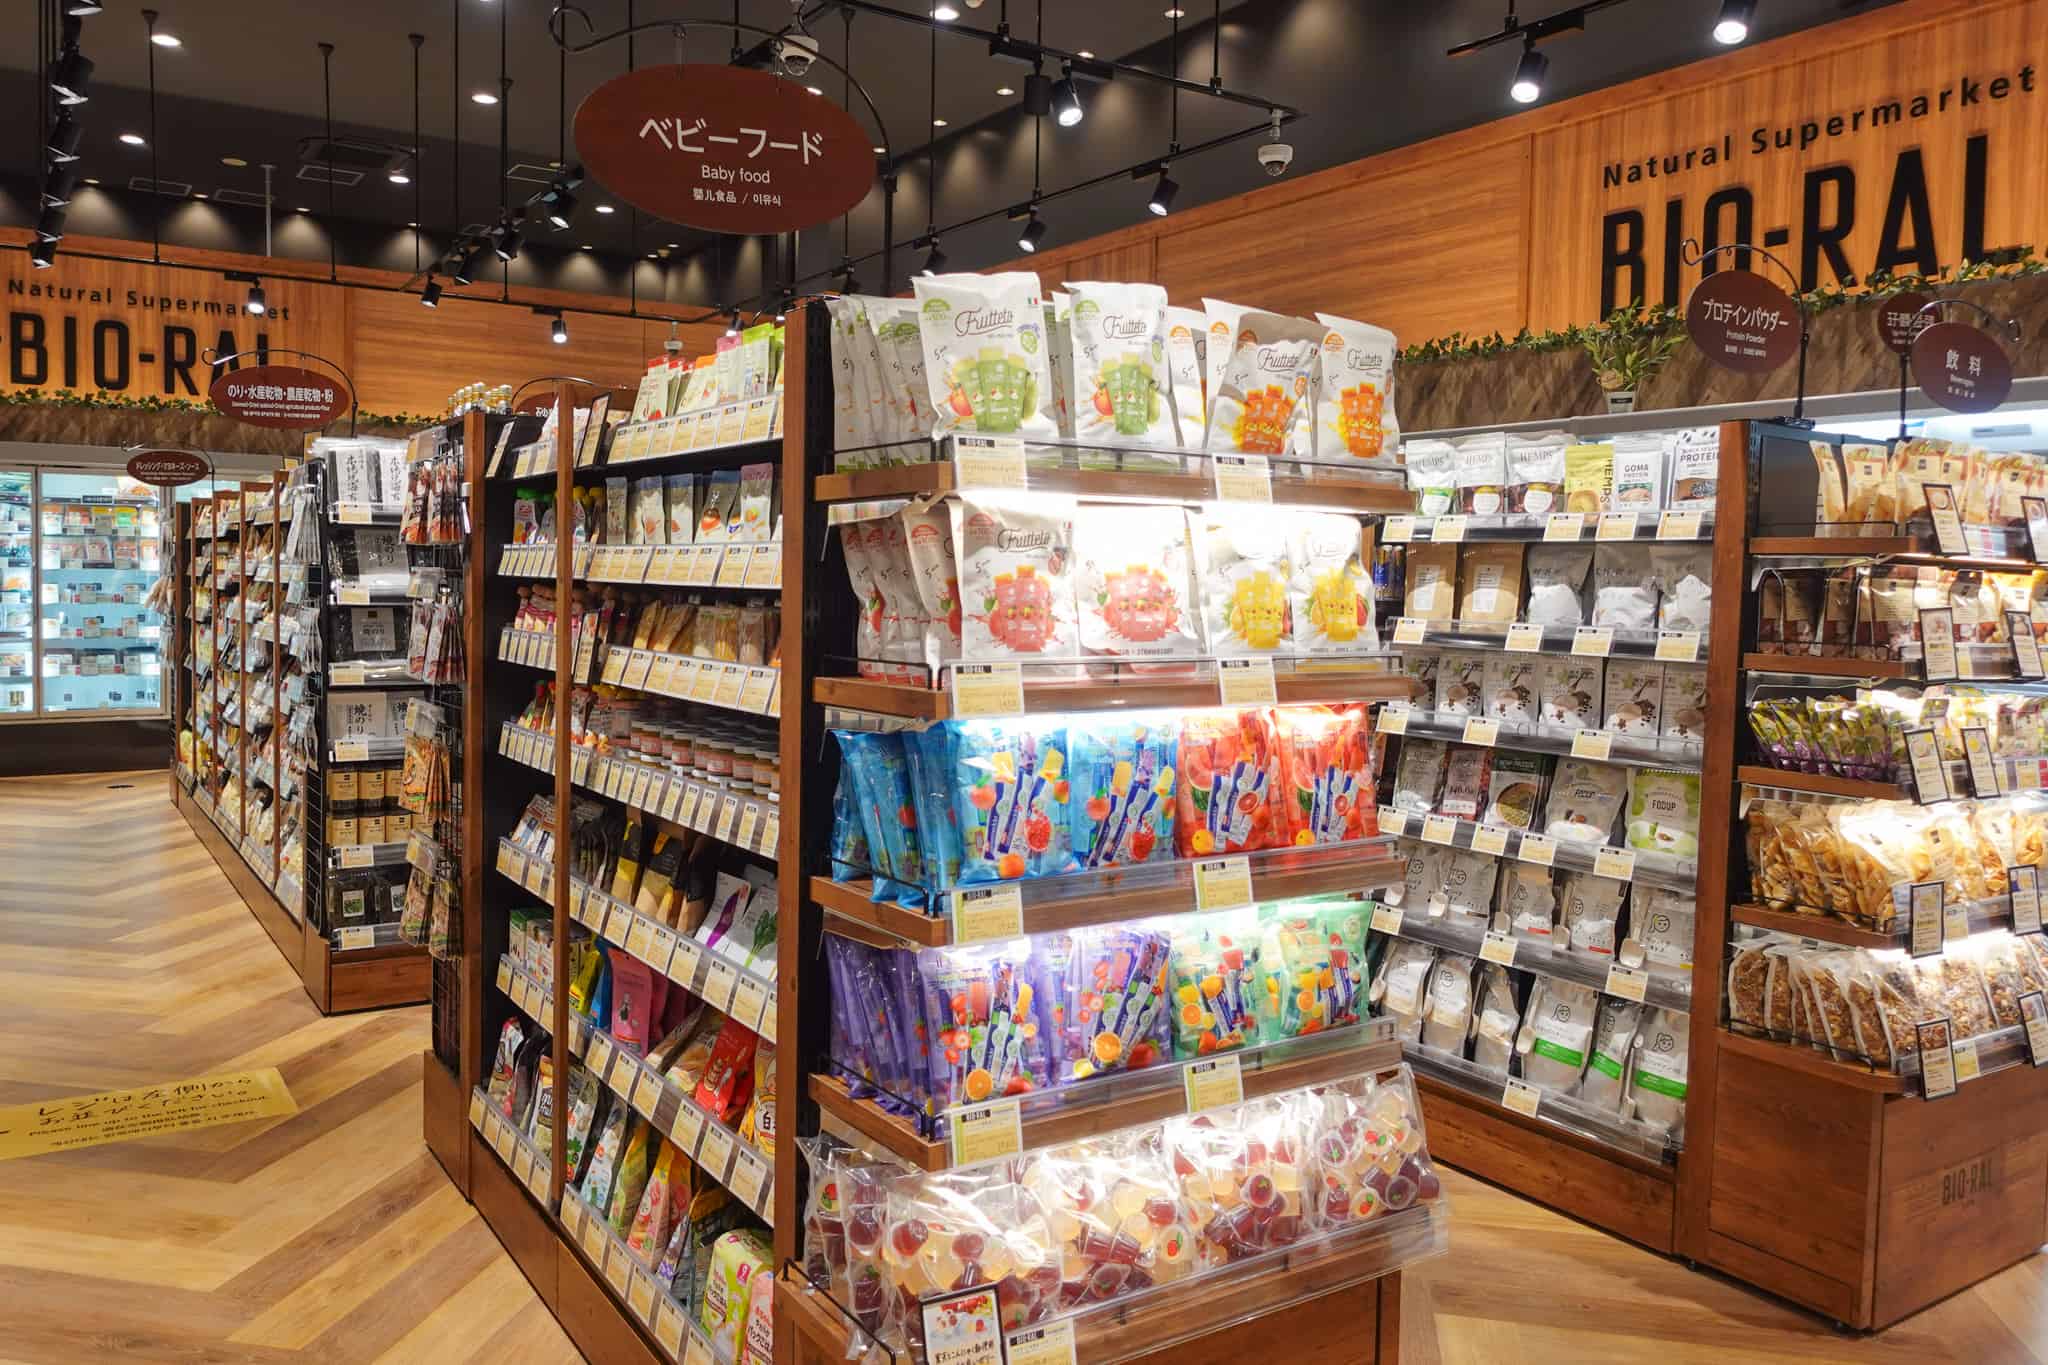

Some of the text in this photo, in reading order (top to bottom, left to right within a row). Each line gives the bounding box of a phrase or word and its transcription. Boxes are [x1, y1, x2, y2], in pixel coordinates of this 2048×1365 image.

[640, 118, 823, 165] ベビーフード
[1603, 66, 2034, 189] Natural Supermarket
[701, 165, 770, 184] Baby food
[753, 193, 782, 207] 이유식
[1601, 134, 2034, 322] BIO-RAL
[8, 279, 290, 321] Natural Supermaret
[1703, 298, 1789, 331] プロテインパウダー
[1625, 464, 1649, 472] GOMA
[1680, 453, 1715, 462] PROTEI
[1600, 459, 1613, 503] HEMPS
